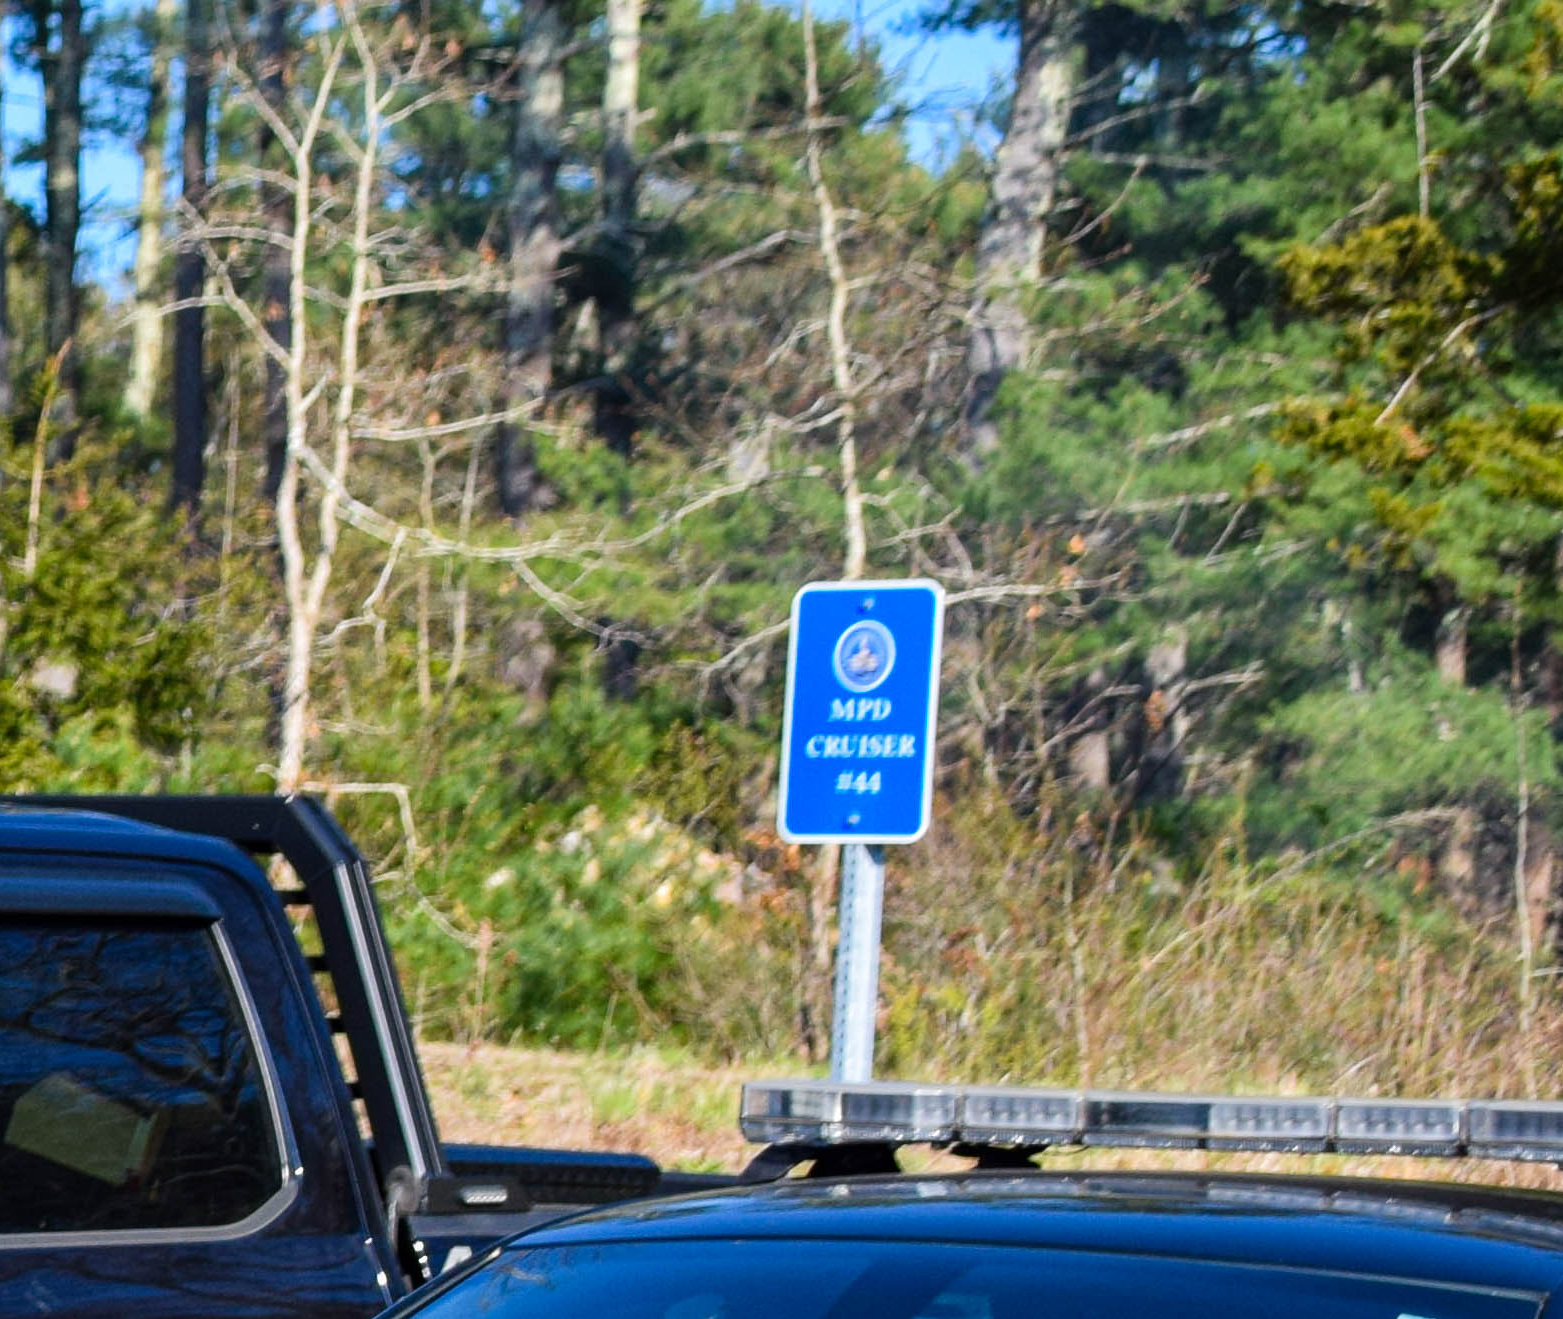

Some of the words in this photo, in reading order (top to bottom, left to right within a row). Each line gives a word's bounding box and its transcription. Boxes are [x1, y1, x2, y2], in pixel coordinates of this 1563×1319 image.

[828, 698, 892, 721] MPD
[805, 734, 916, 758] CRUISER
[835, 771, 882, 794] #44
